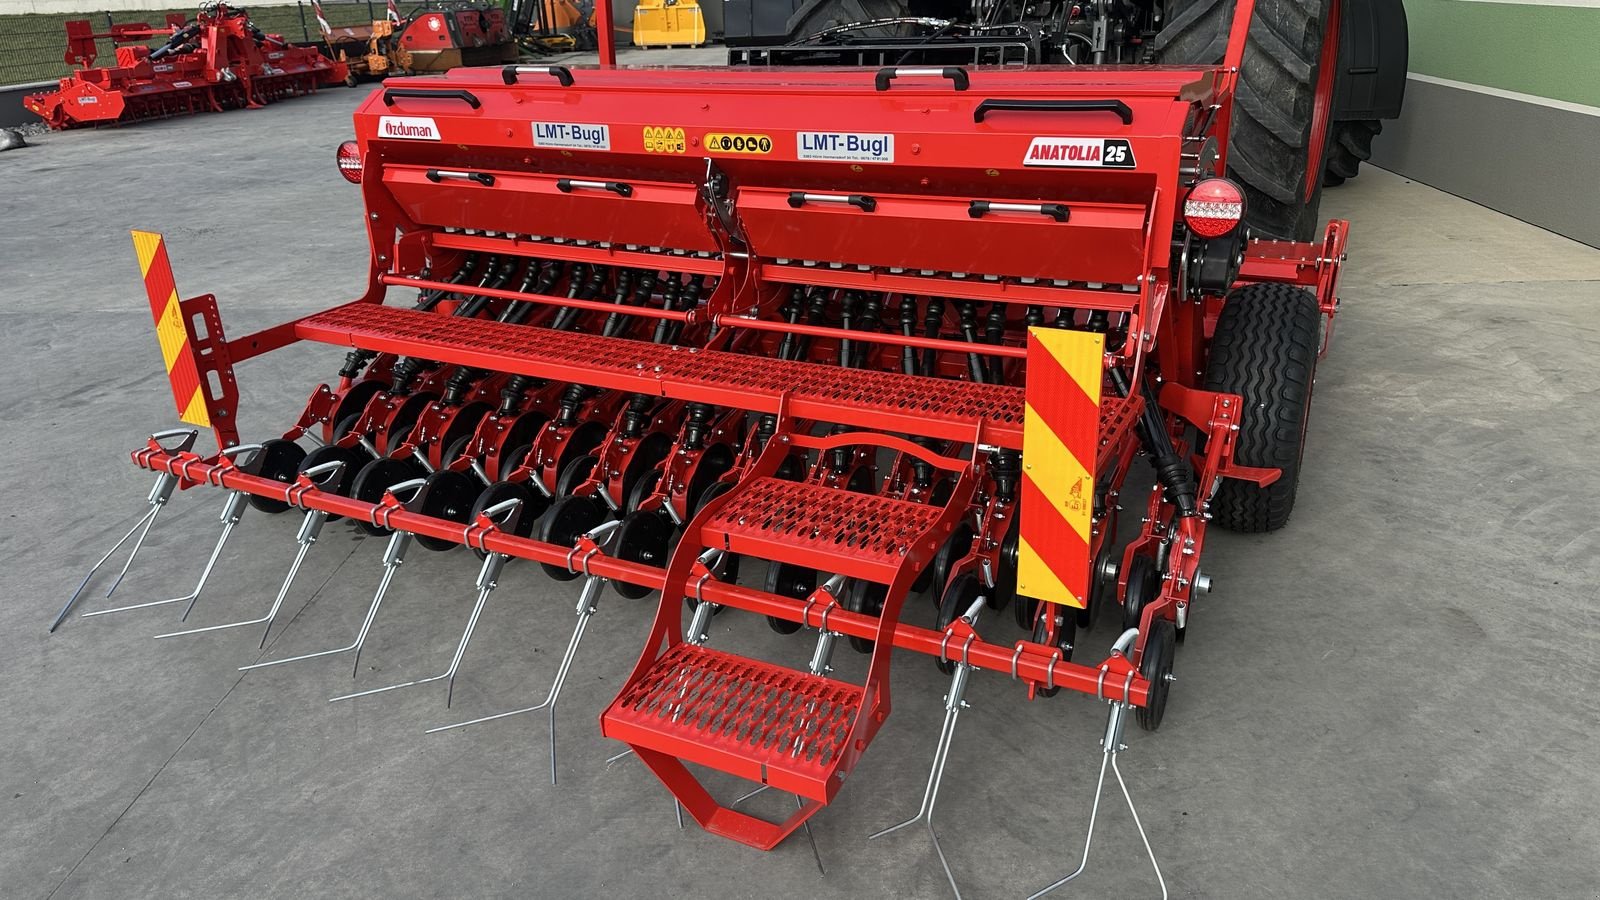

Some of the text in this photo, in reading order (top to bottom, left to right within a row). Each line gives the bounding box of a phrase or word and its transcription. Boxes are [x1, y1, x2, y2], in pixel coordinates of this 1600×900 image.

[385, 119, 433, 137] Özduman
[536, 123, 605, 145] LMT-Bugl
[802, 133, 888, 157] LMT-Bugl
[1029, 144, 1127, 163] ANATOLIA 25
